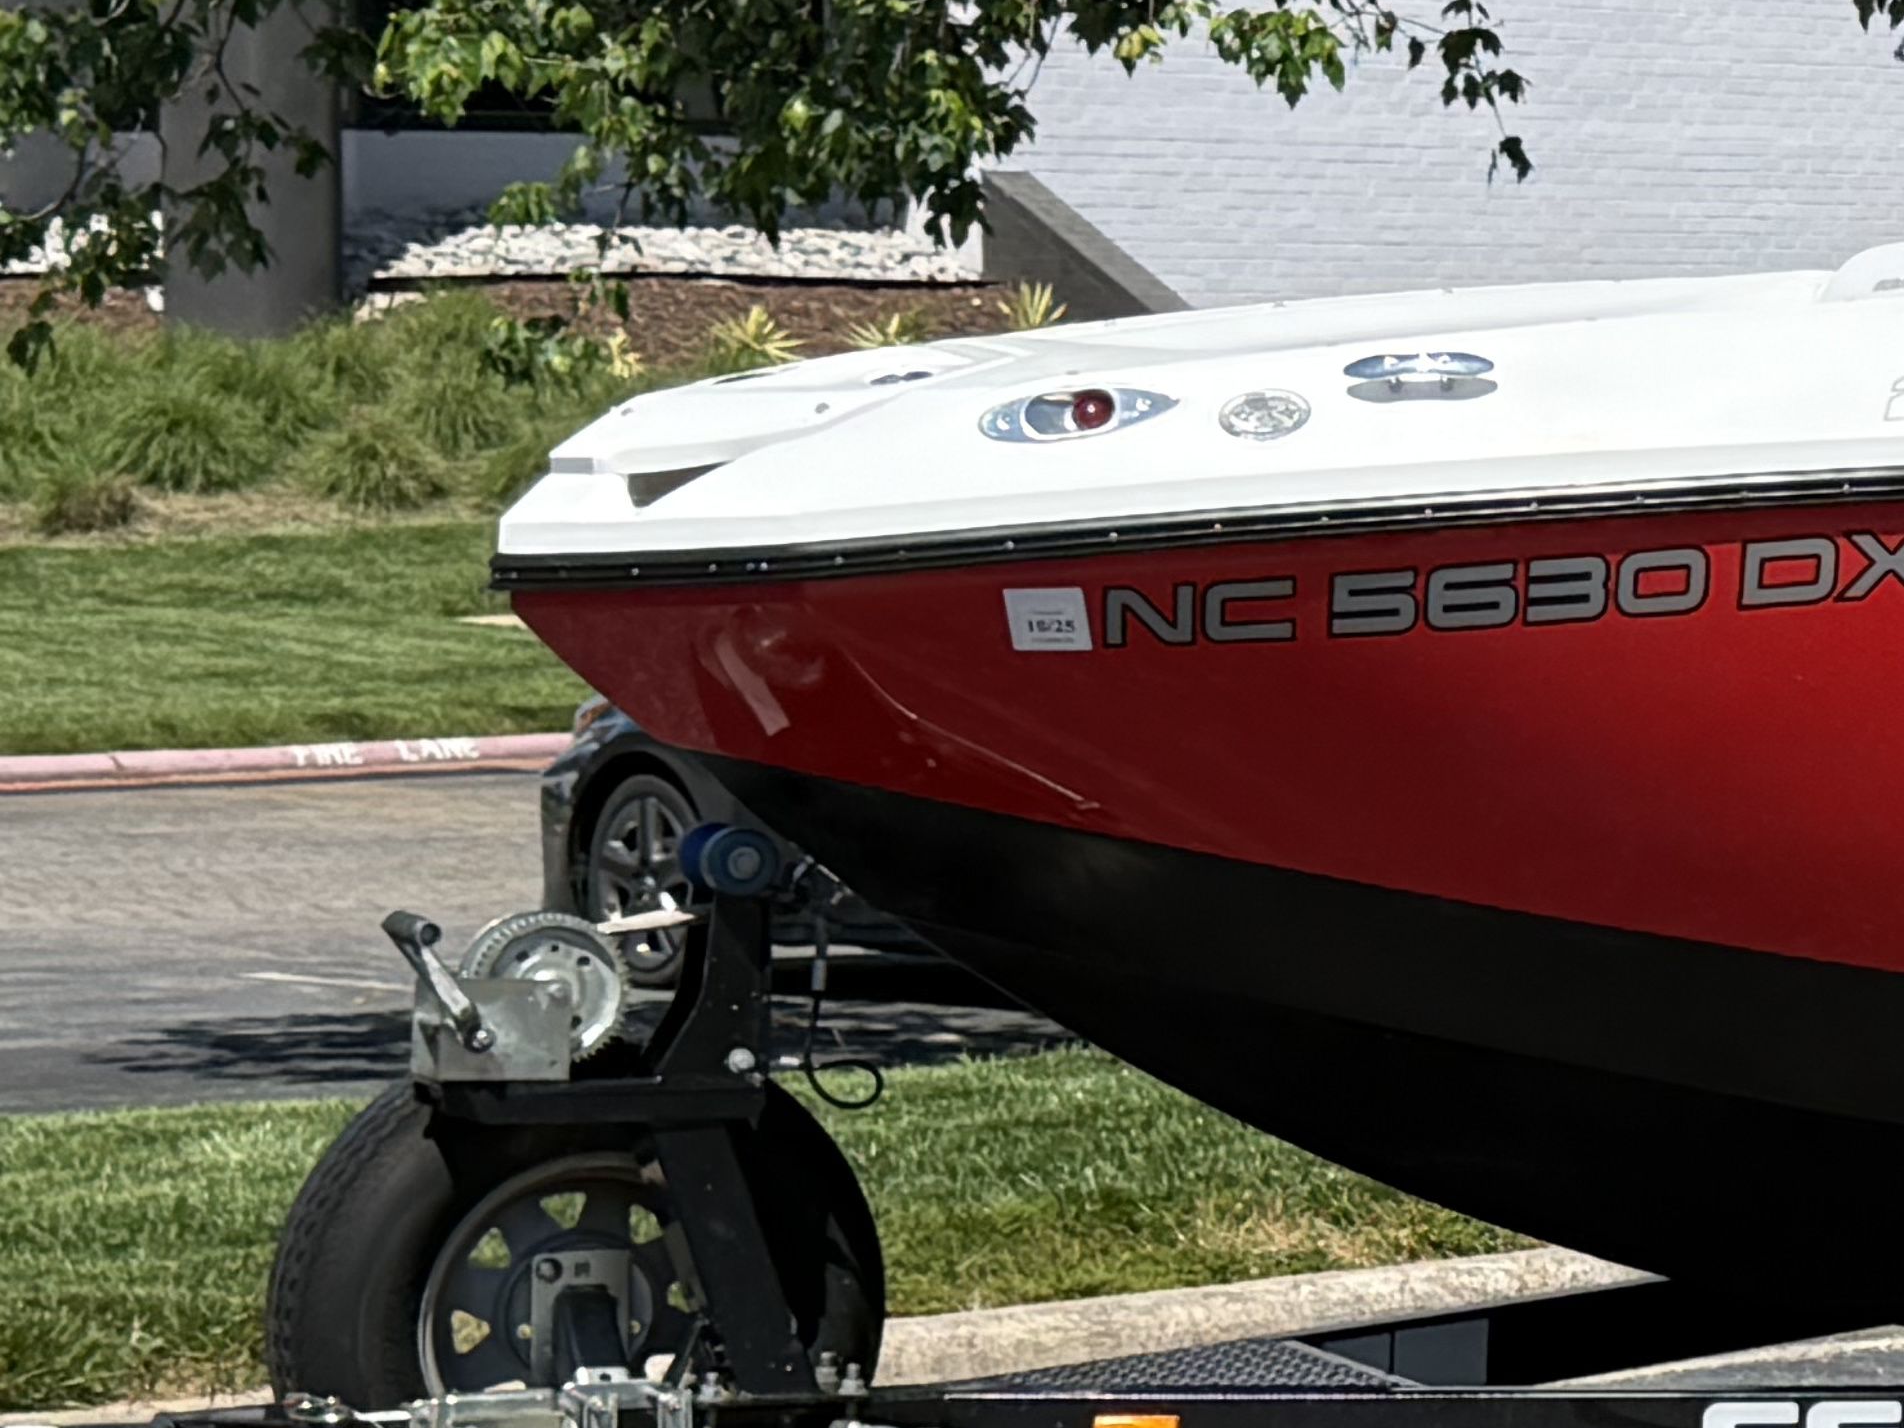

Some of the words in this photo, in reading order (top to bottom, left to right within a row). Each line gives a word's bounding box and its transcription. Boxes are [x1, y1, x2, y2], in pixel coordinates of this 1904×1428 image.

[1103, 575, 1297, 648] NC
[1327, 543, 1711, 639] 5630
[394, 738, 479, 762] LANE
